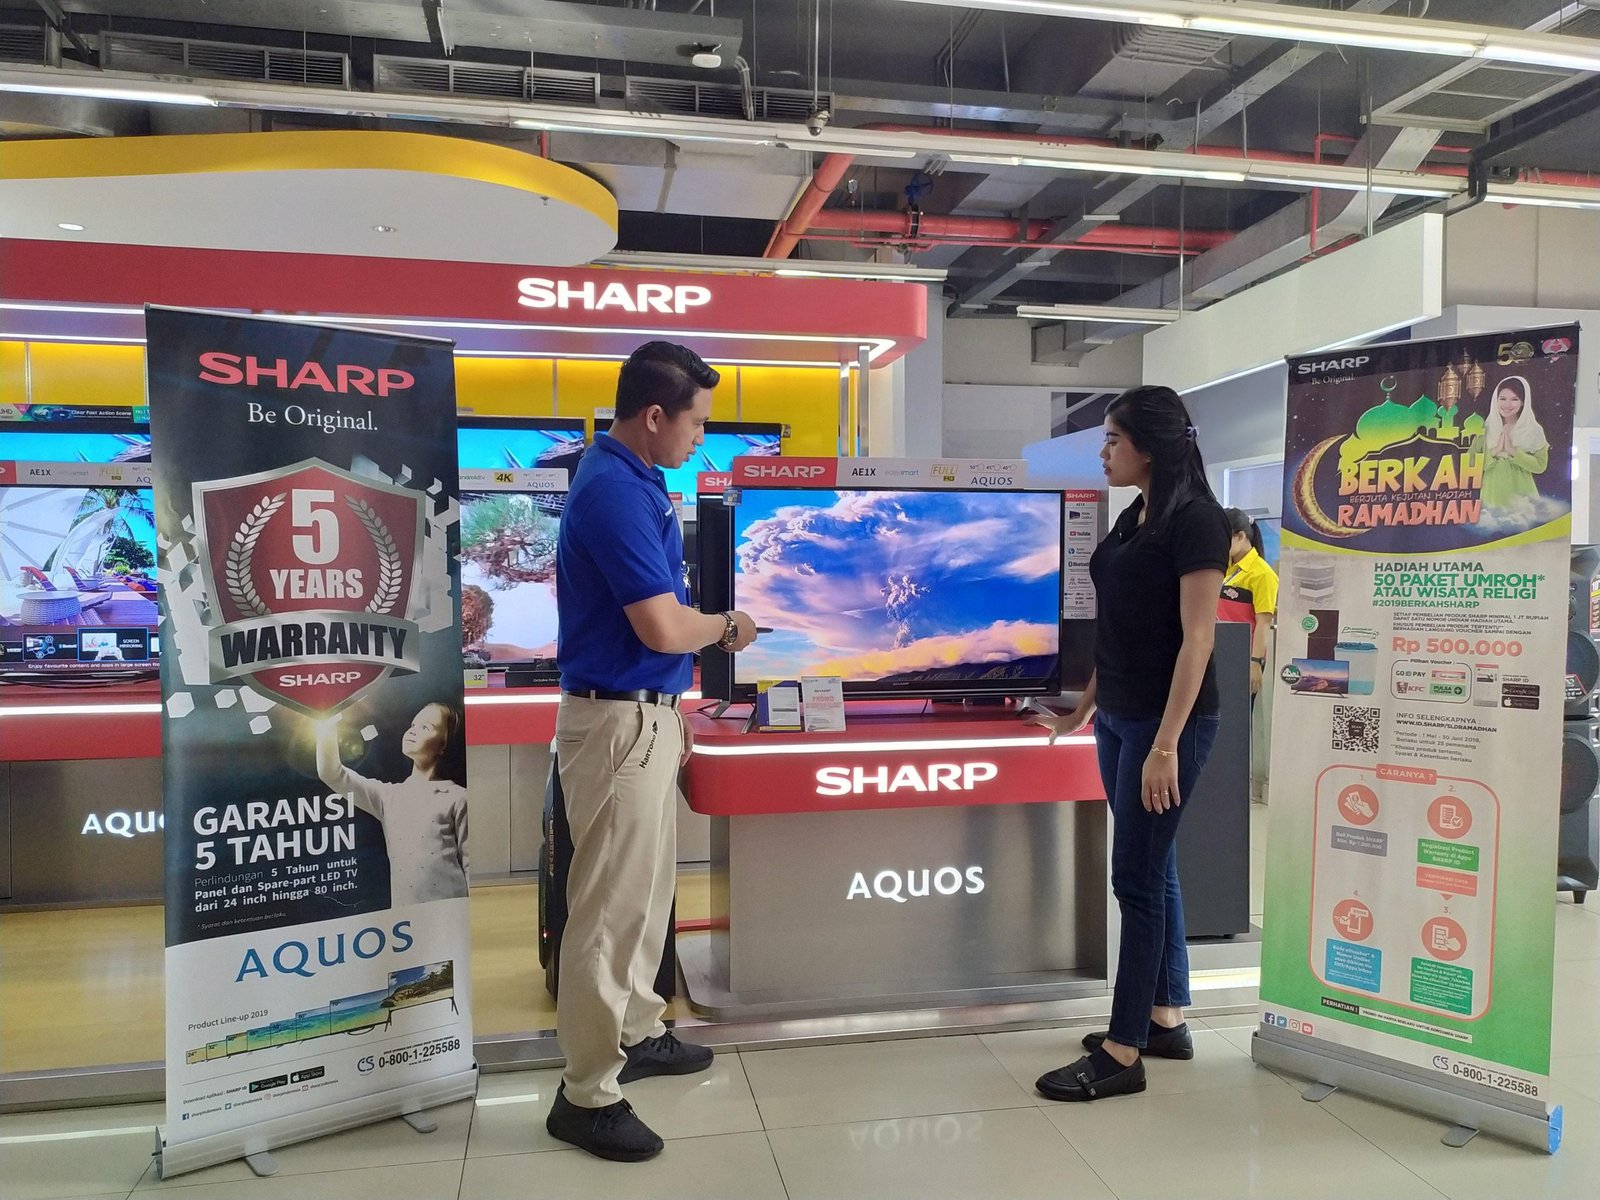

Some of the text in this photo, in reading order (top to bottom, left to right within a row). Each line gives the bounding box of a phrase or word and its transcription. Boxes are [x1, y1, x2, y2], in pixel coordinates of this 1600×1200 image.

[518, 277, 711, 314] SHARP
[199, 352, 415, 397] SHARP
[1298, 356, 1369, 374] SHARP
[1323, 372, 1355, 384] Original.
[248, 403, 378, 434] Be Original.
[30, 468, 51, 476] AE1X
[495, 472, 513, 482] 4K
[743, 465, 826, 478] SHARP
[851, 468, 876, 477] AE1X
[932, 465, 958, 475] FULL
[1338, 453, 1484, 496] BERKAH
[970, 477, 1013, 487] AQUOS
[1350, 491, 1472, 503] BERJUTA KEJUTAN HADIAH
[1338, 500, 1481, 527] RAMADHAN
[292, 489, 339, 564] 5
[1374, 562, 1484, 572] HADIAH UTAMA
[269, 568, 363, 599] YEARS
[1374, 574, 1395, 586] 50
[1401, 574, 1459, 587] PAKET
[1372, 600, 1480, 608] #2019BERKAHSHARP
[1373, 587, 1536, 599] ATAU WISATA RELIGI
[220, 621, 408, 668] WARRANTY
[1392, 637, 1523, 657] Rp 500.000
[279, 671, 361, 687] SHARP
[1416, 714, 1476, 724] SELENGKAPNYA
[816, 762, 998, 796] SHARP
[1379, 768, 1426, 780] CARANYA
[193, 792, 355, 835] GARANSI
[195, 823, 355, 870] 5 TAHUN
[194, 857, 357, 888] Perlindungan 5 Tahun untuk
[195, 868, 358, 900] Panel dan Spare-part LED TV
[846, 866, 985, 903] AQUOS
[195, 881, 358, 912] dari 24 inch hingga 80 inch.
[235, 921, 413, 983] AQUOS
[1323, 998, 1354, 1012] PERHATIAN
[188, 1009, 269, 1031] Product Line-up 2019
[379, 1039, 460, 1068] 0-800-1-225588
[1452, 1064, 1538, 1097] 0-800-1-225588
